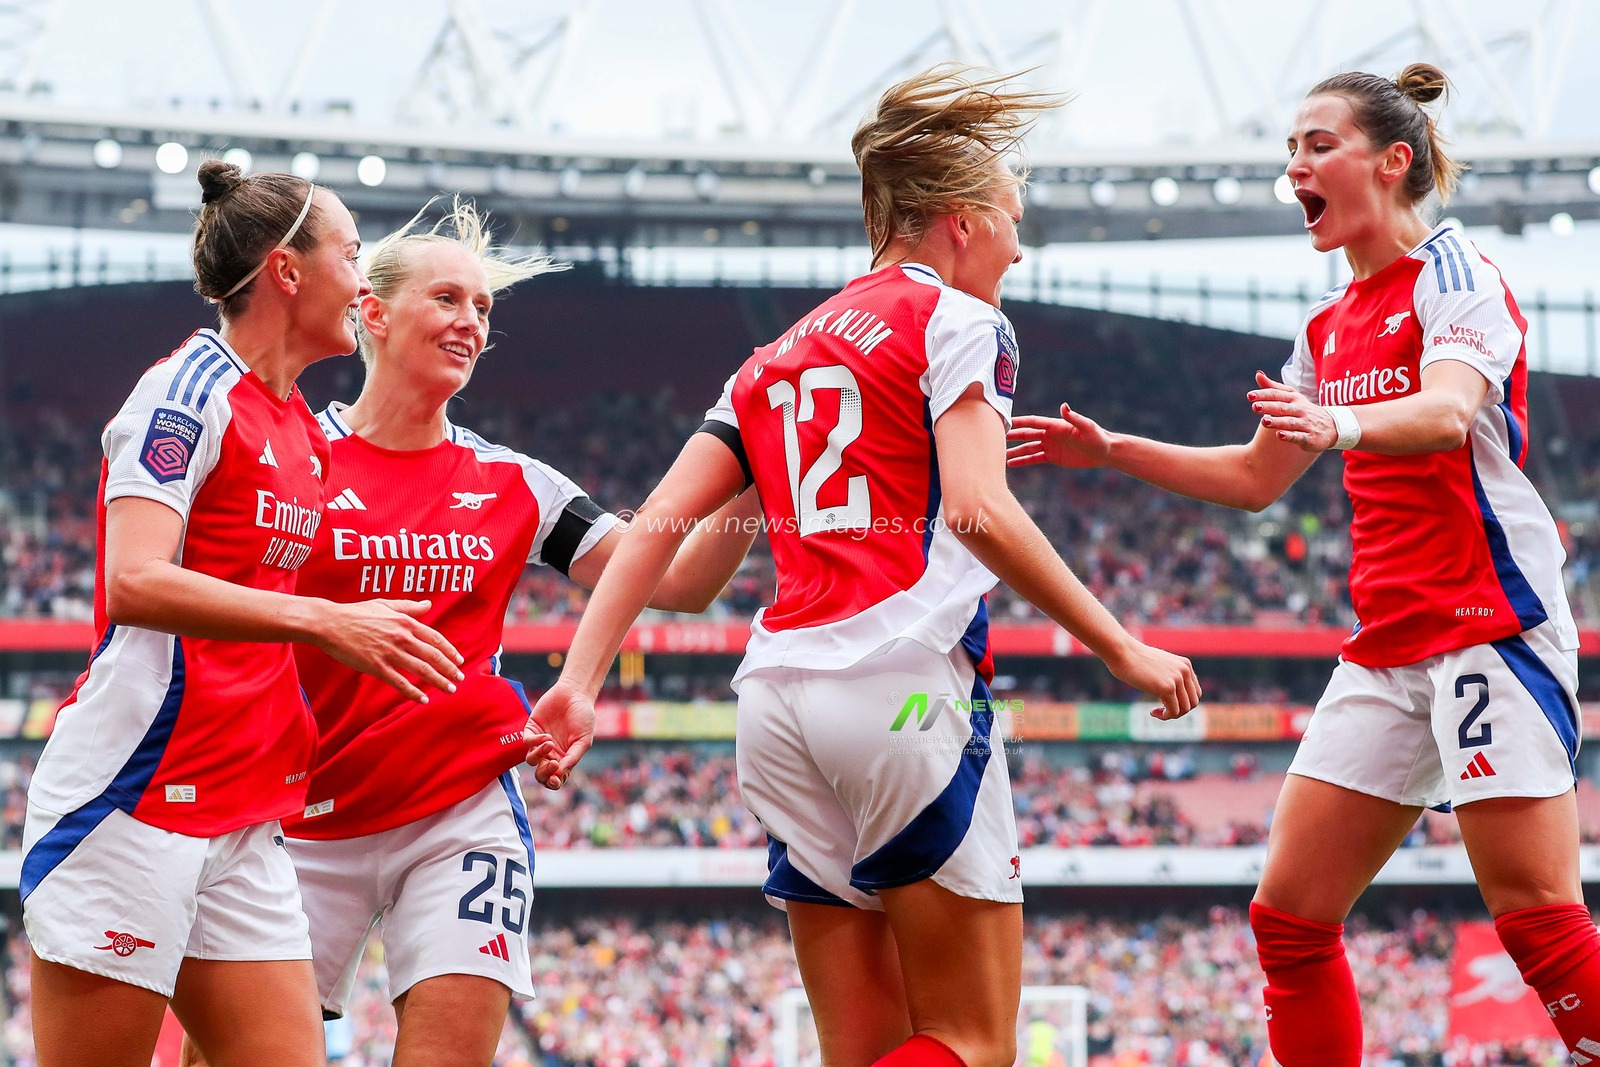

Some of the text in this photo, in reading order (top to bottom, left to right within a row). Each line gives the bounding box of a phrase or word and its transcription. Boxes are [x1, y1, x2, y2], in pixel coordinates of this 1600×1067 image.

[774, 308, 894, 356] MAANUM
[1449, 324, 1486, 341] VISIT
[1433, 336, 1497, 361] RWANDA
[1318, 365, 1411, 406] Emirates
[154, 424, 195, 445] SUPER LEAGUE
[156, 419, 197, 440] WOMEN'S
[167, 413, 199, 433] BARCLAYS
[766, 364, 872, 539] 12
[255, 489, 322, 540] Emirate
[261, 536, 313, 571] FLY BETT
[331, 527, 495, 561] Emirates
[360, 564, 475, 593] FLY BETTER
[1455, 607, 1495, 617] HEAT.RDY
[1454, 673, 1492, 749] 2
[500, 730, 525, 746] HEAT.R
[457, 851, 527, 935] 25
